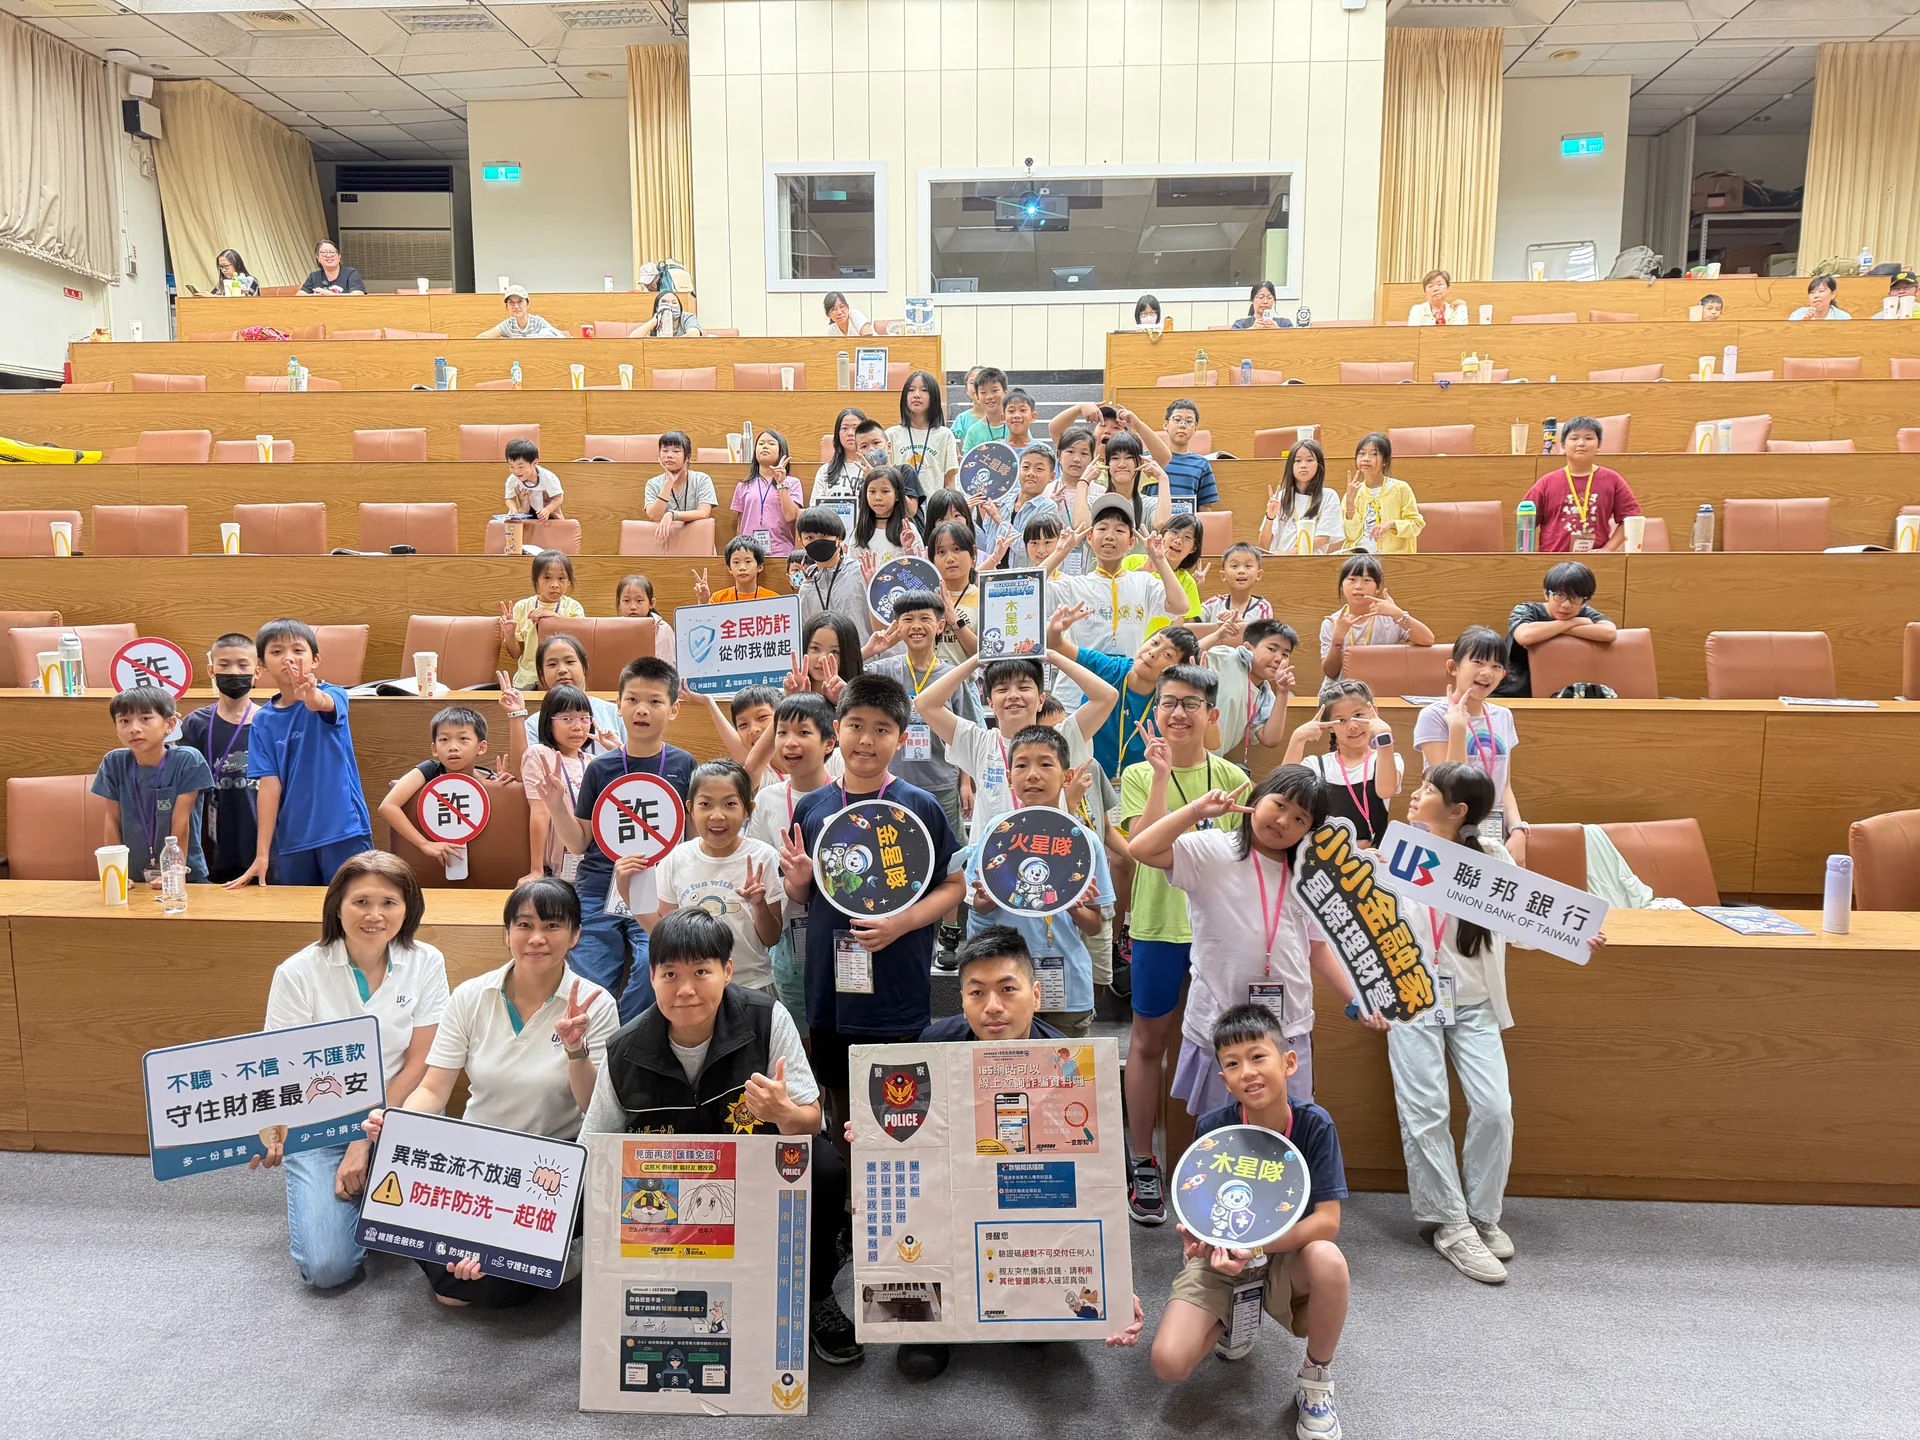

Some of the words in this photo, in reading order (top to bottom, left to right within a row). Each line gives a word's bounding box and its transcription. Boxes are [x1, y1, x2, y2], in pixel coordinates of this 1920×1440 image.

[978, 453, 1011, 476] 土星隊
[896, 568, 930, 590] 水星
[720, 613, 791, 639] 全民防詐
[1005, 600, 1018, 637] 木星隊
[719, 639, 792, 661] 從你我做起
[131, 656, 172, 688] 詐
[436, 792, 470, 827] 詐
[617, 798, 660, 844] 詐
[875, 823, 908, 890] 金星隊
[1009, 832, 1073, 857] 火星隊
[690, 880, 708, 890] fun
[711, 880, 734, 890] with
[1452, 861, 1591, 931] 聯邦銀行
[1314, 825, 1435, 1014] 小小金融家
[1446, 888, 1483, 912] UNION
[1484, 901, 1516, 923] BANK
[1517, 913, 1536, 928] OF
[1536, 922, 1581, 948] TAIWAN
[1300, 869, 1397, 1011] 星際理財營
[166, 1042, 367, 1093] 不聽、不信、不匯款
[978, 1063, 1041, 1076] 165網站可以
[165, 1083, 304, 1128] 守住財產最
[344, 1072, 369, 1096] 安
[884, 1113, 919, 1127] POLICE
[182, 1146, 248, 1167] 多一份警覺
[300, 1122, 363, 1142] 少一份損失
[635, 1149, 673, 1160] 見面再談
[391, 1144, 522, 1189] 異常金流不放過
[782, 1168, 801, 1176] POLICE
[1209, 1152, 1285, 1183] 木星隊
[409, 1180, 558, 1234] 防詐防洗一起做
[866, 1161, 878, 1262] 臺北市政府警察局
[881, 1161, 892, 1236] 文山第一分局
[895, 1160, 907, 1223] 指南派出所
[378, 1231, 425, 1249] 維護金融秩序
[506, 1259, 553, 1279] 守護社會安全
[985, 1232, 1009, 1241] 提醒您
